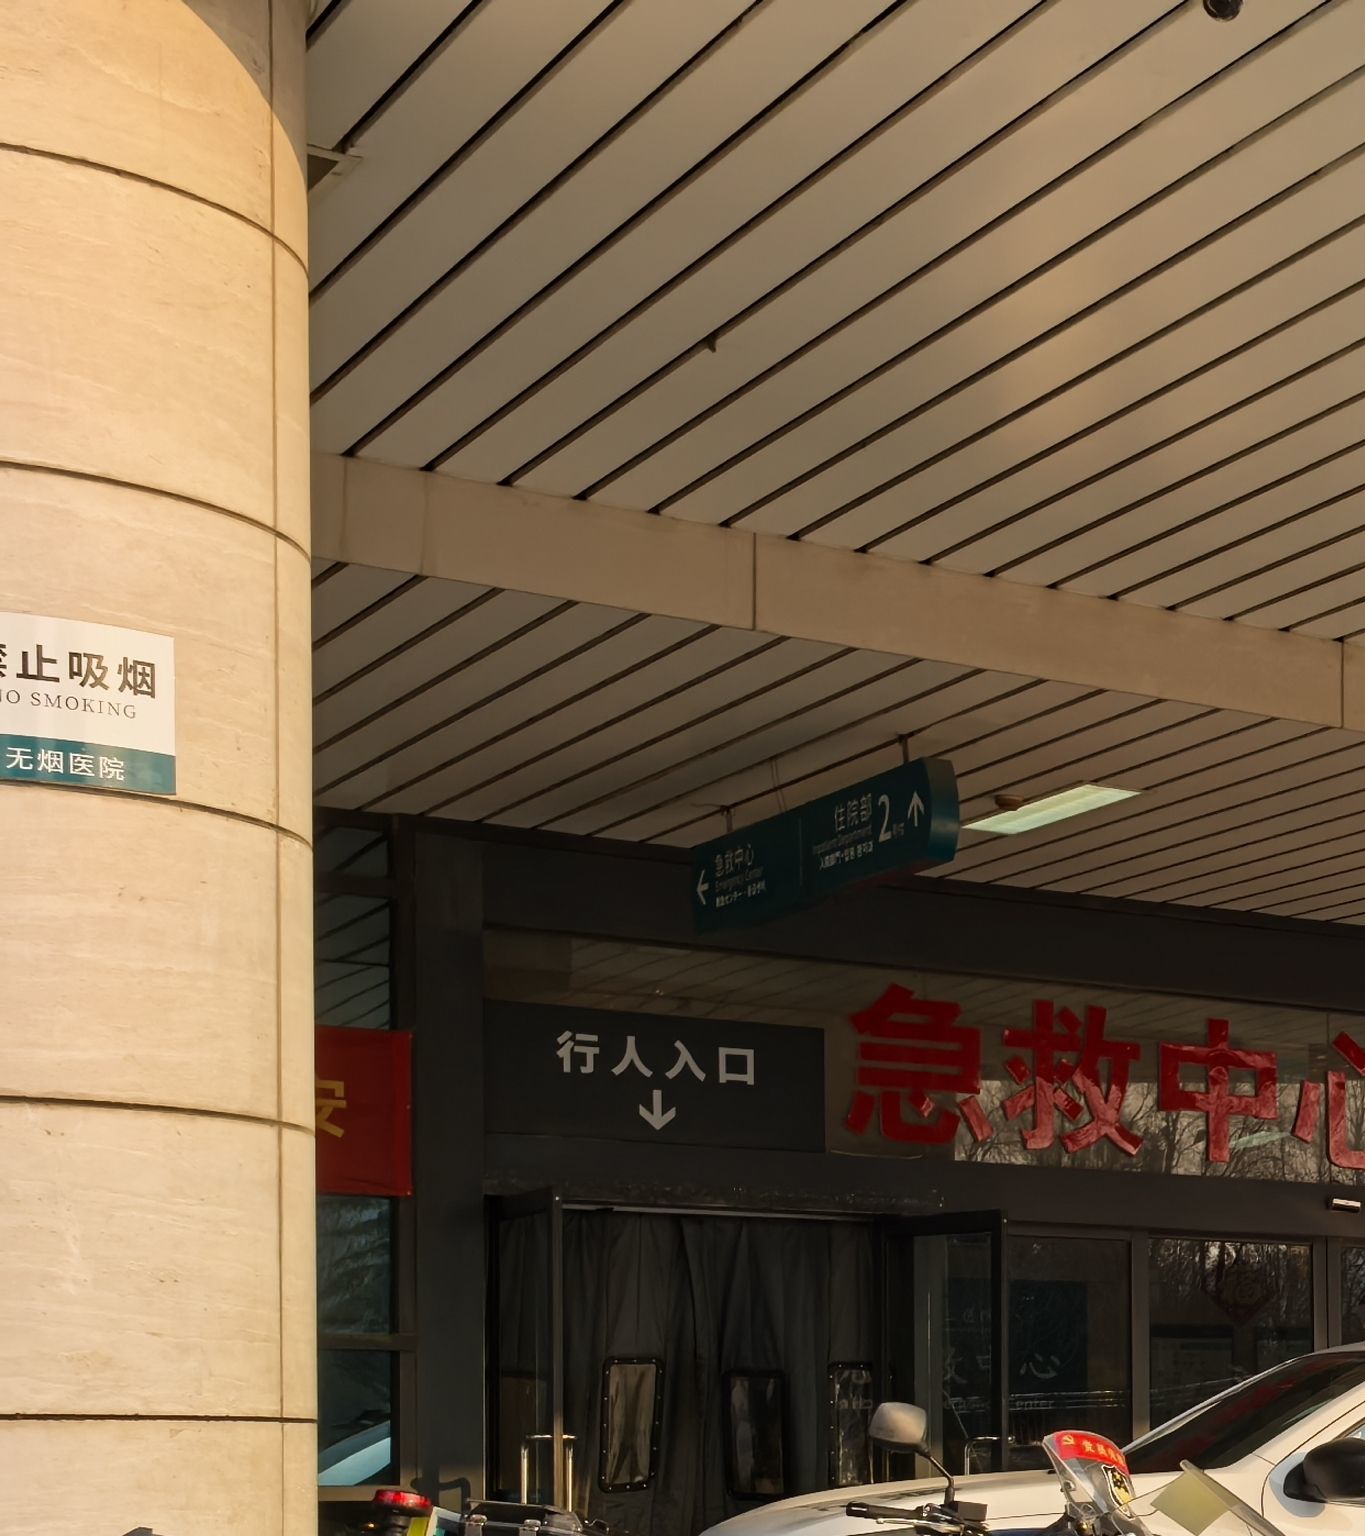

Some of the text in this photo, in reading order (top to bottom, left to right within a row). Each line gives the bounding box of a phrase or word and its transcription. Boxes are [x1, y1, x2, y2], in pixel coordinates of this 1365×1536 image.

[30, 692, 136, 719] SMOKING
[6, 747, 125, 781] 无烟医院
[878, 794, 892, 842] 2
[556, 1030, 755, 1085] 行人入口
